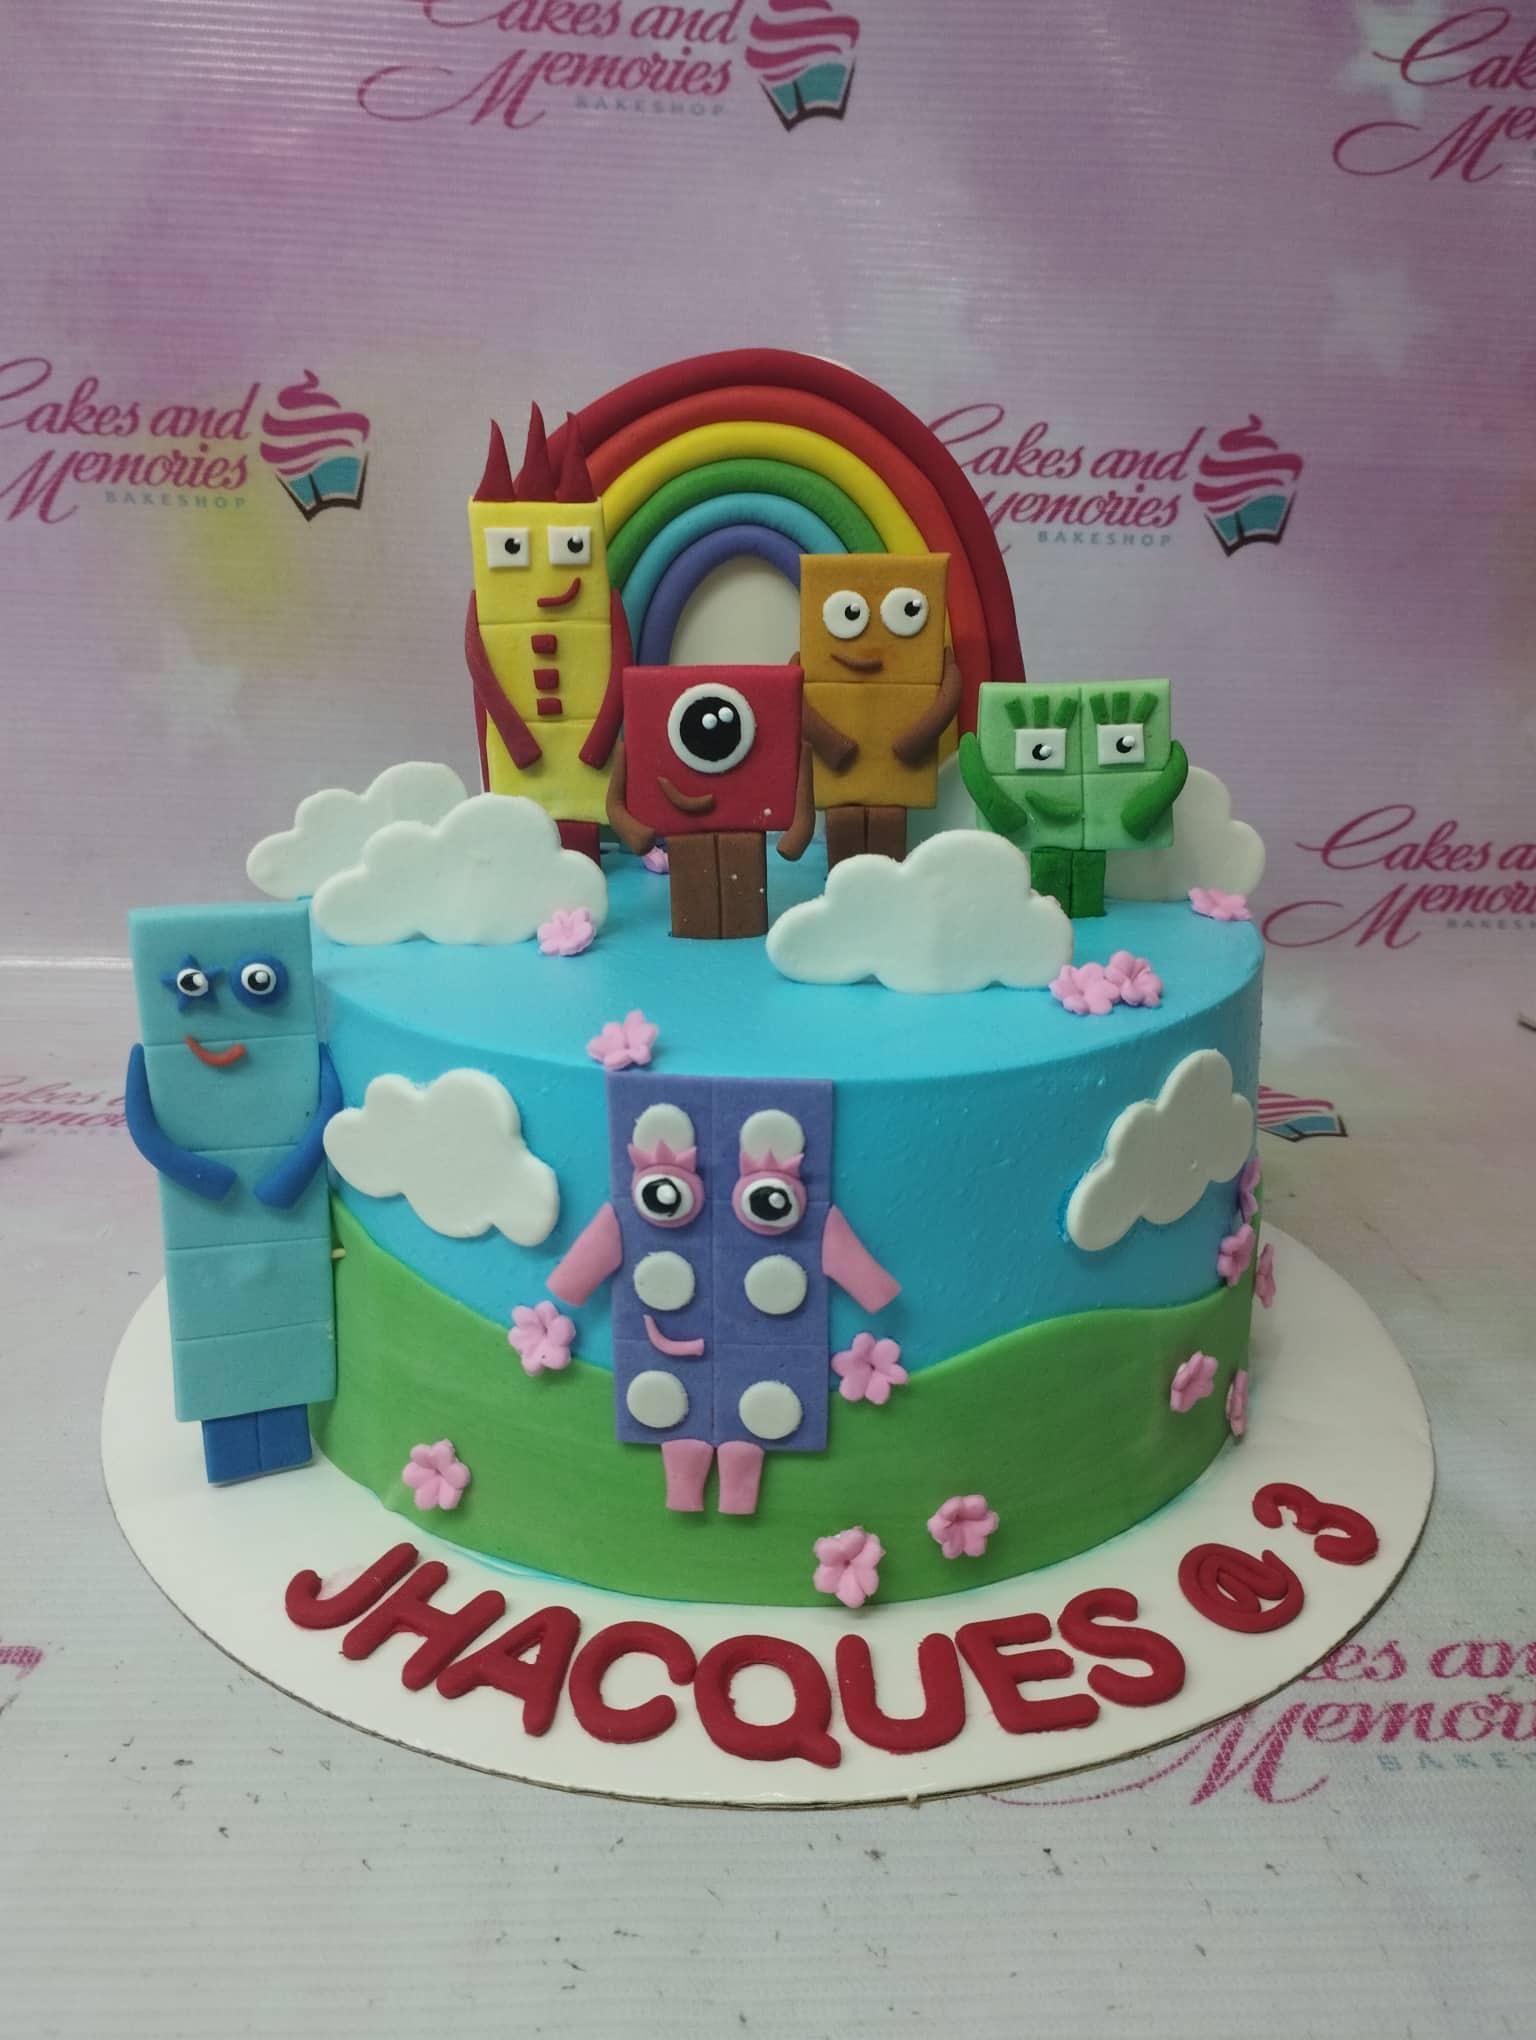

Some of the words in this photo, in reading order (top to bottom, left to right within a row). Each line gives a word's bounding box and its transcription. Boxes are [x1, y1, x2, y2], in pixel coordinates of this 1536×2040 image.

[629, 0, 745, 44] and
[357, 46, 732, 129] Memories
[575, 96, 728, 116] BAKESHOP
[150, 382, 260, 440] and
[1090, 427, 1206, 481] and
[0, 443, 249, 524] Memories
[105, 491, 247, 509] BAKESHOP
[1038, 531, 1172, 546] BAKESHOP
[1296, 804, 1494, 872] Cakes
[285, 1543, 1187, 1768] JHACQUES
[1178, 1543, 1304, 1633] @
[1252, 1482, 1379, 1566] 3
[1300, 1640, 1407, 1681] es
